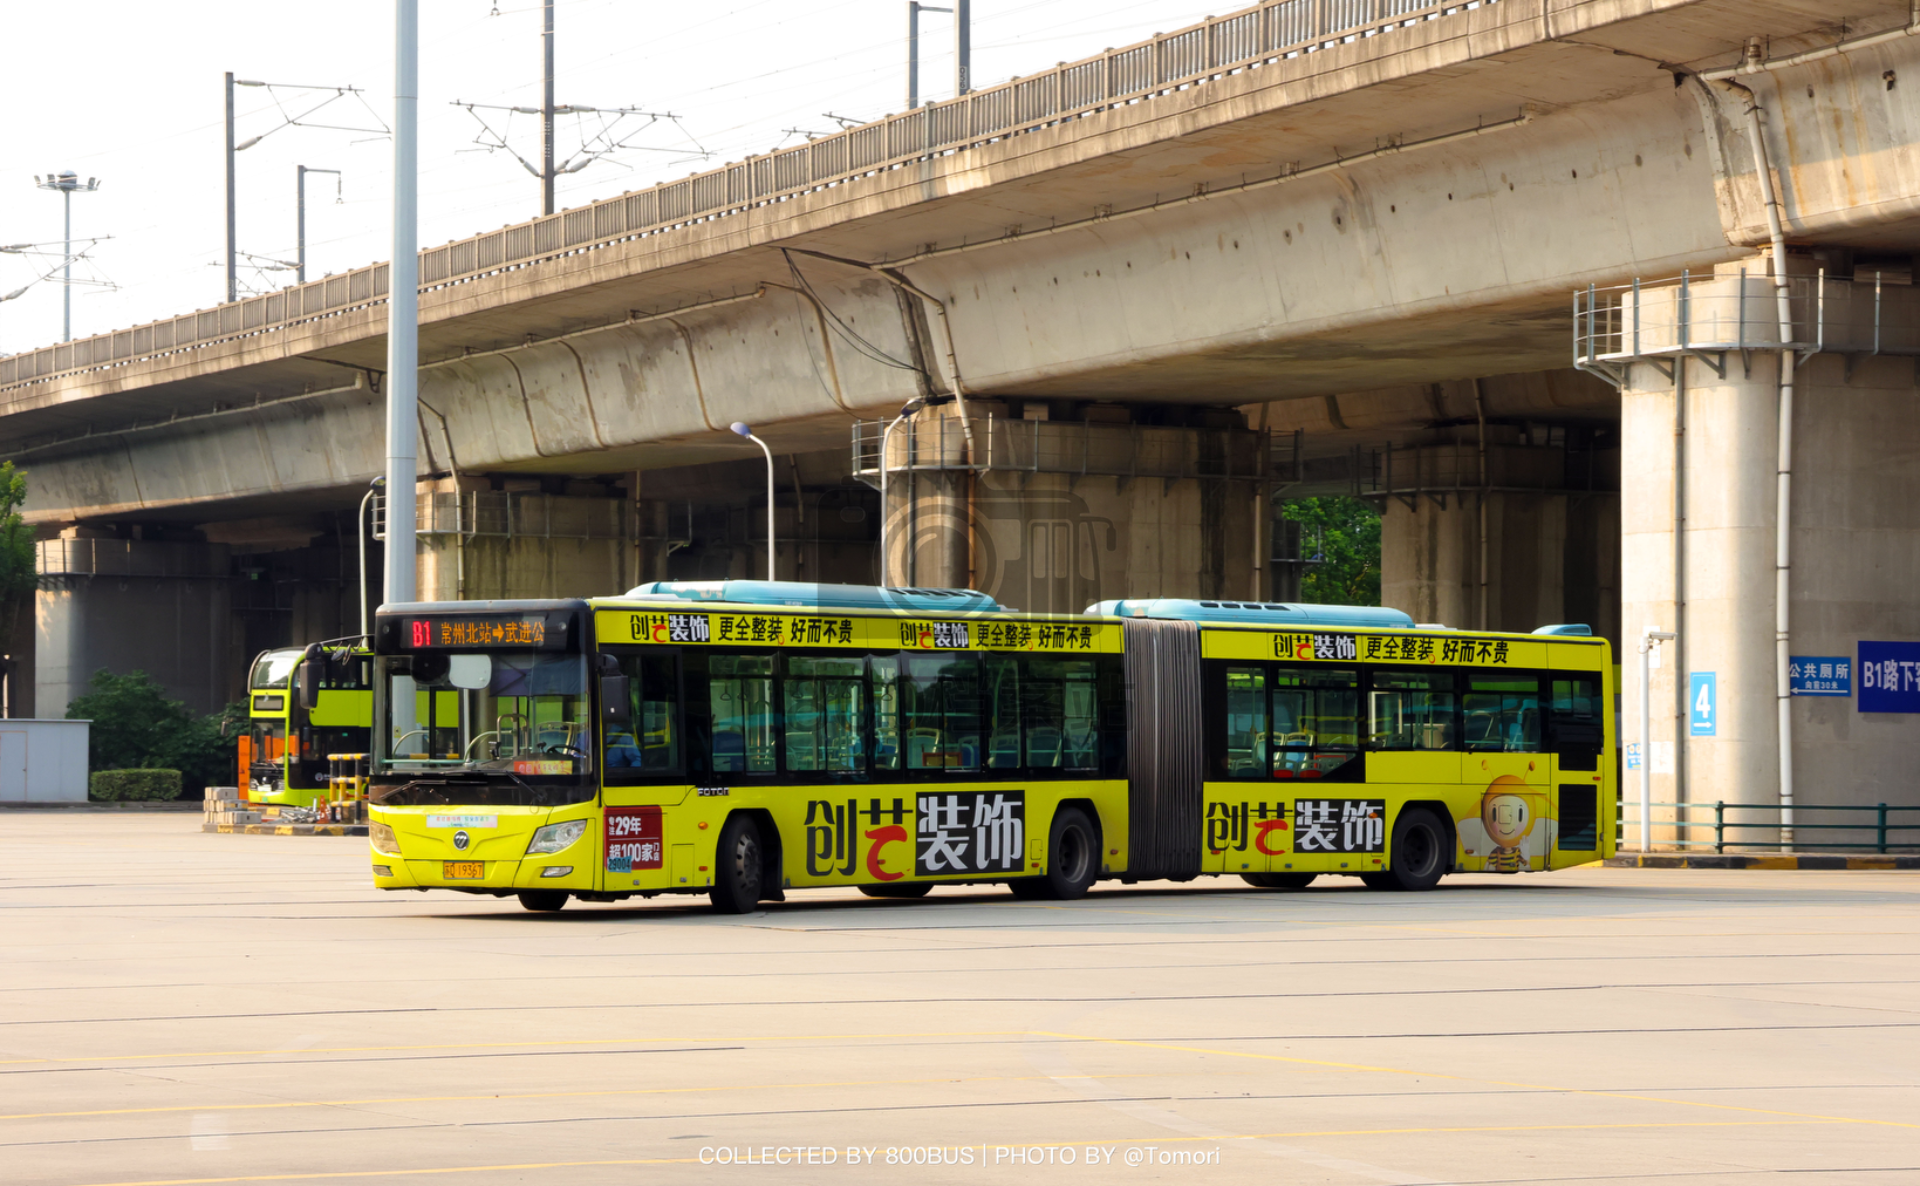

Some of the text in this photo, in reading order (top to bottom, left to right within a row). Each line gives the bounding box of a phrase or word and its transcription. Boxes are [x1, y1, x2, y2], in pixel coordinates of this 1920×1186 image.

[412, 620, 432, 648] B1
[440, 620, 545, 645] 常州北站 武进公
[630, 614, 710, 643] 创艺装饰
[790, 617, 853, 644] 好而不贵
[900, 622, 969, 649] 创艺装饰
[1038, 625, 1092, 649] 好而不贵
[1273, 634, 1356, 660] 创艺装饰
[1442, 638, 1509, 664] 好而不贵
[1789, 663, 1849, 679] 公共厕所
[1695, 684, 1711, 719] 4
[803, 794, 1024, 881] 创艺装饰
[1205, 800, 1385, 856] 创艺装饰
